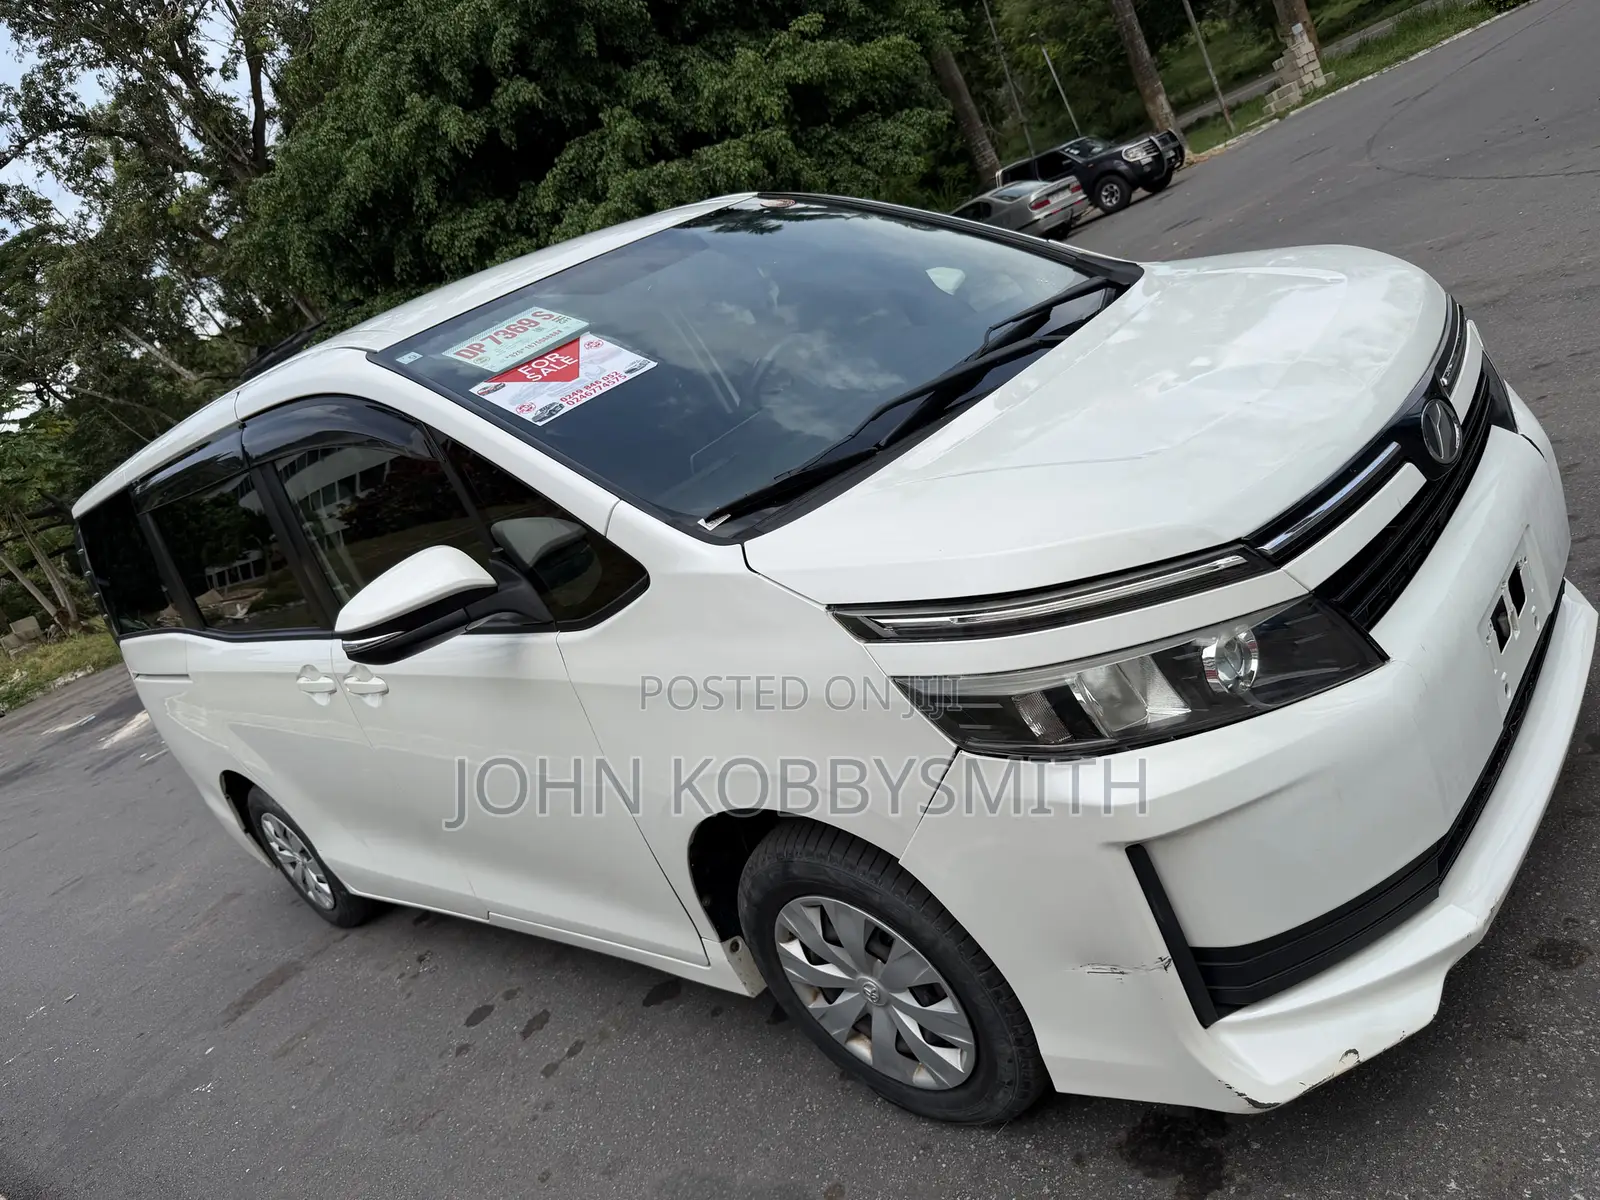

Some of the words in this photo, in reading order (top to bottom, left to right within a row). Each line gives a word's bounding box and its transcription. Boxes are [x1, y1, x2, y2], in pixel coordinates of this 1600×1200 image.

[454, 342, 487, 359] DP
[482, 318, 541, 346] 7369
[531, 310, 555, 321] S
[518, 352, 563, 376] FOR
[526, 355, 578, 381] SALE
[566, 374, 627, 406] 0246774575
